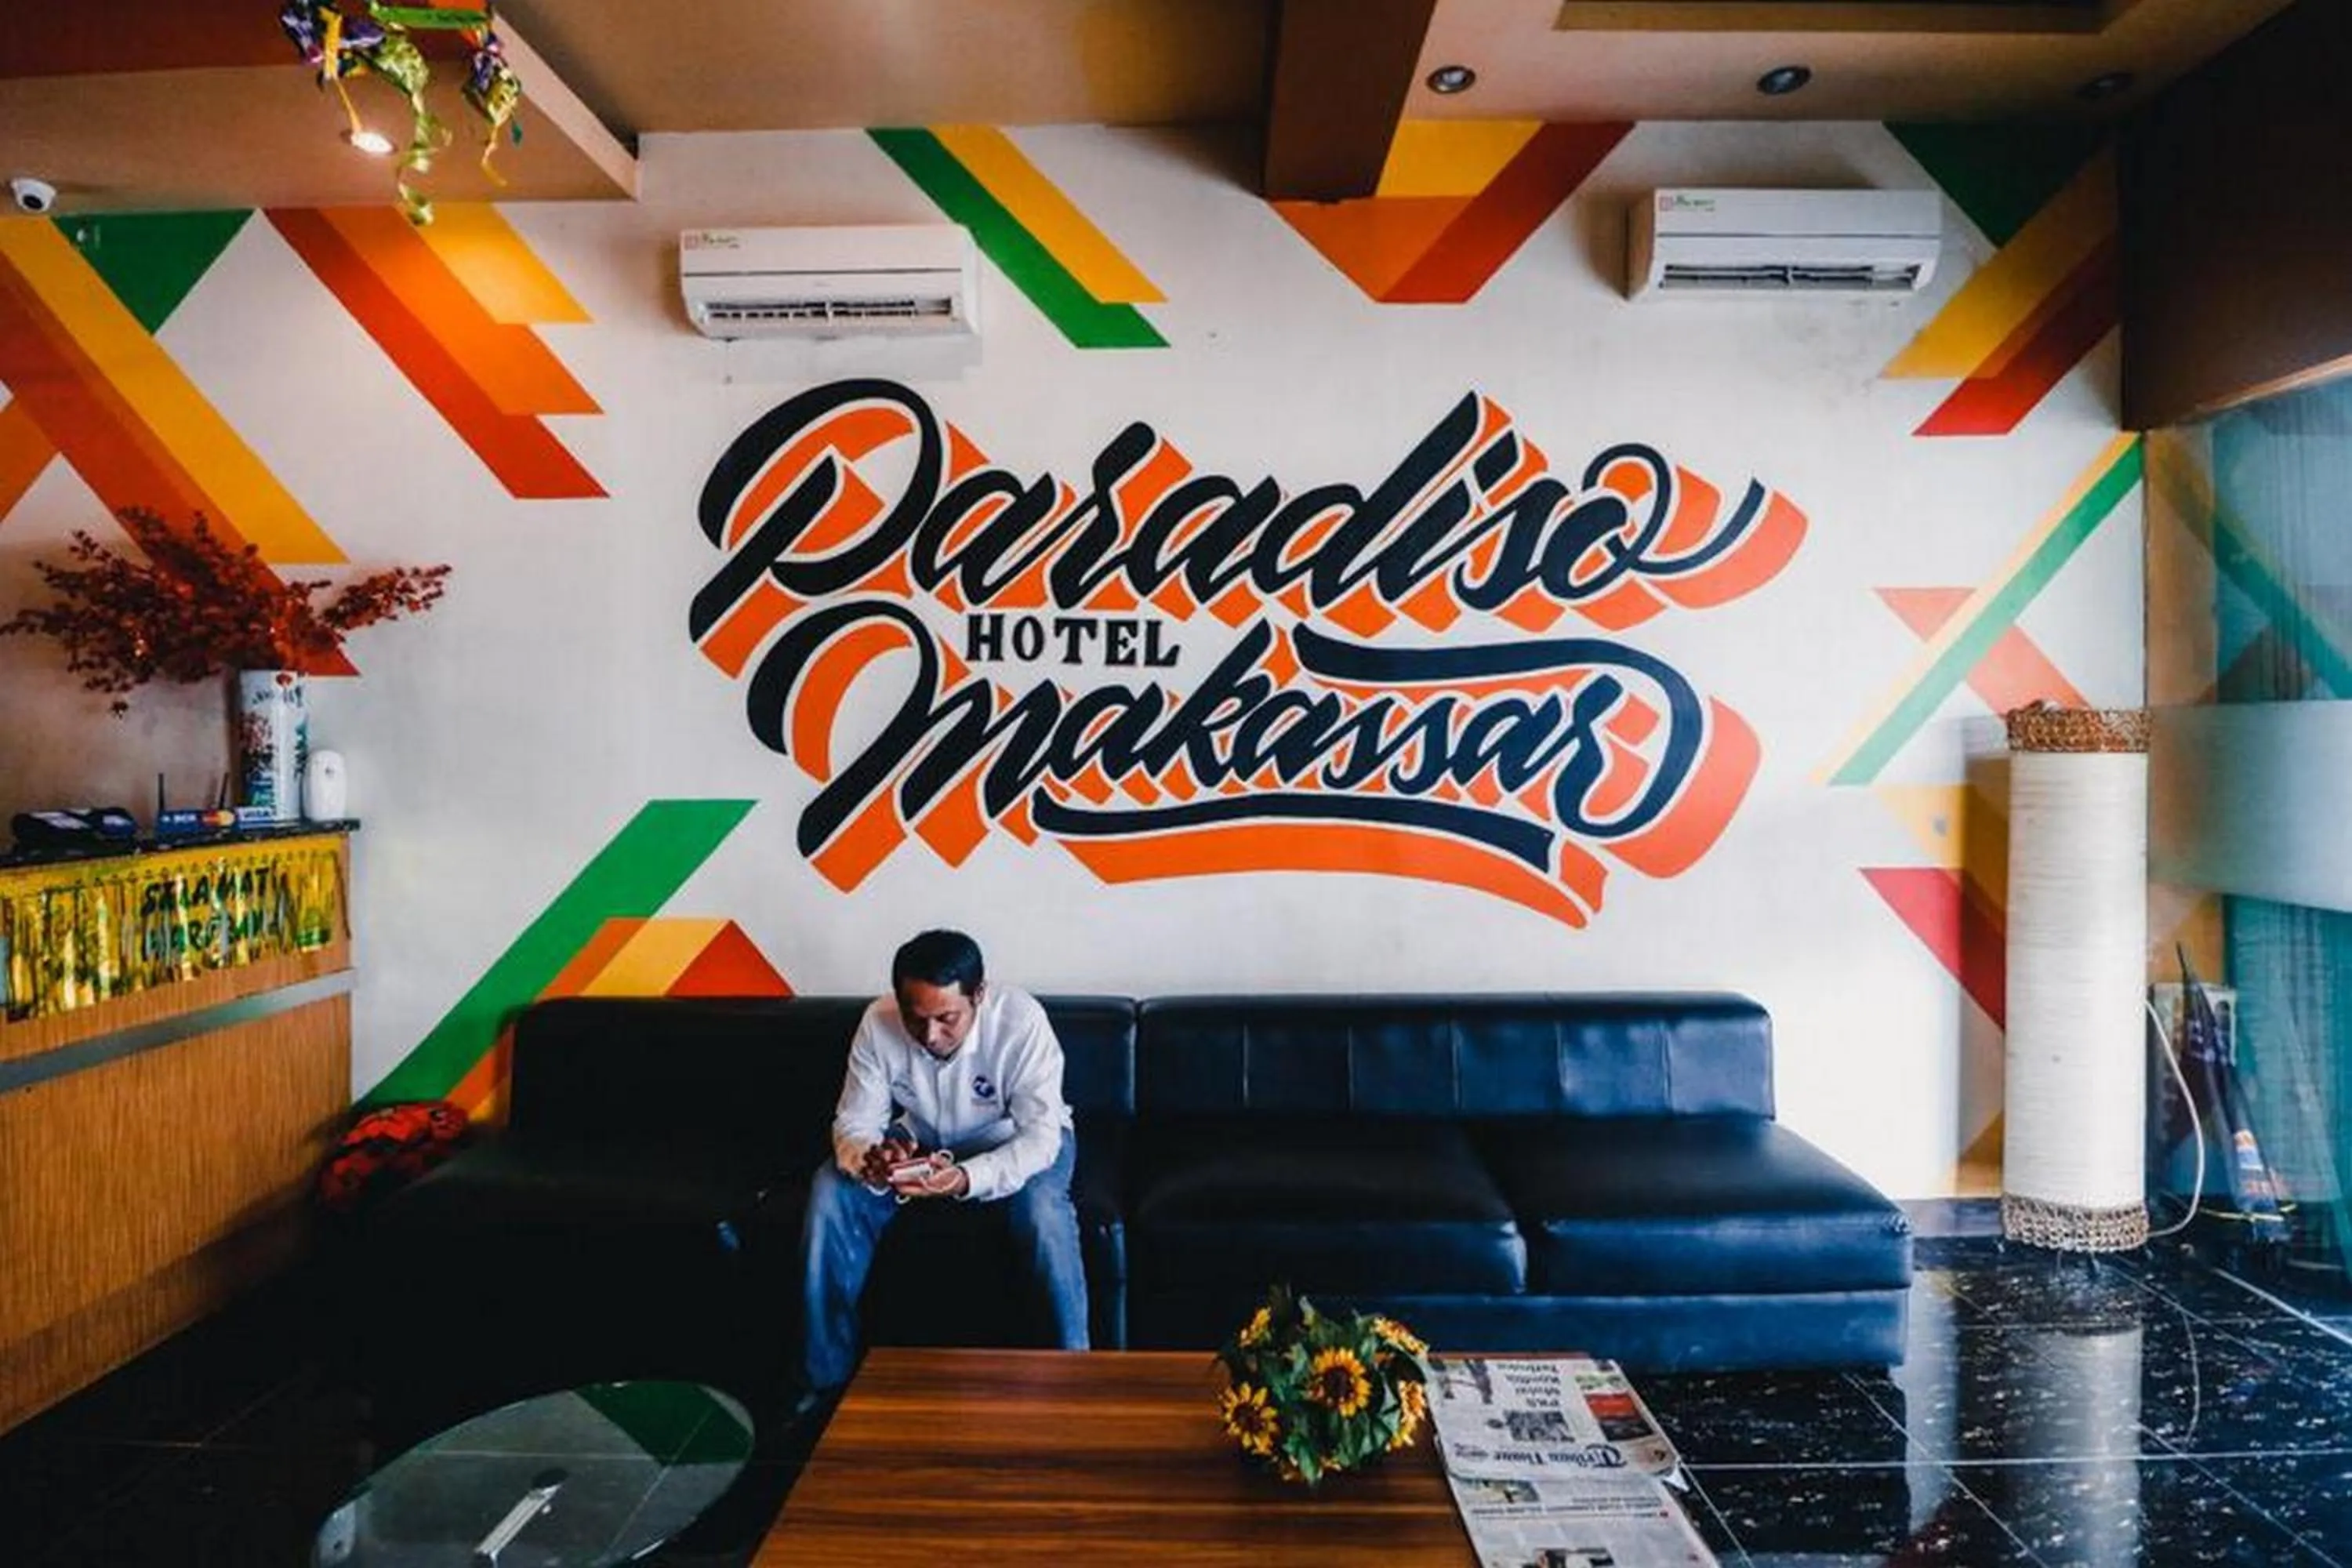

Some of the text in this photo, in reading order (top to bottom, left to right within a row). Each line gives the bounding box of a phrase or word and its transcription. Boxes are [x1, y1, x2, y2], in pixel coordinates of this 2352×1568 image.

[688, 376, 1759, 646] Paradiso
[965, 614, 1181, 667] HOTEL
[745, 599, 1706, 877] Makassar
